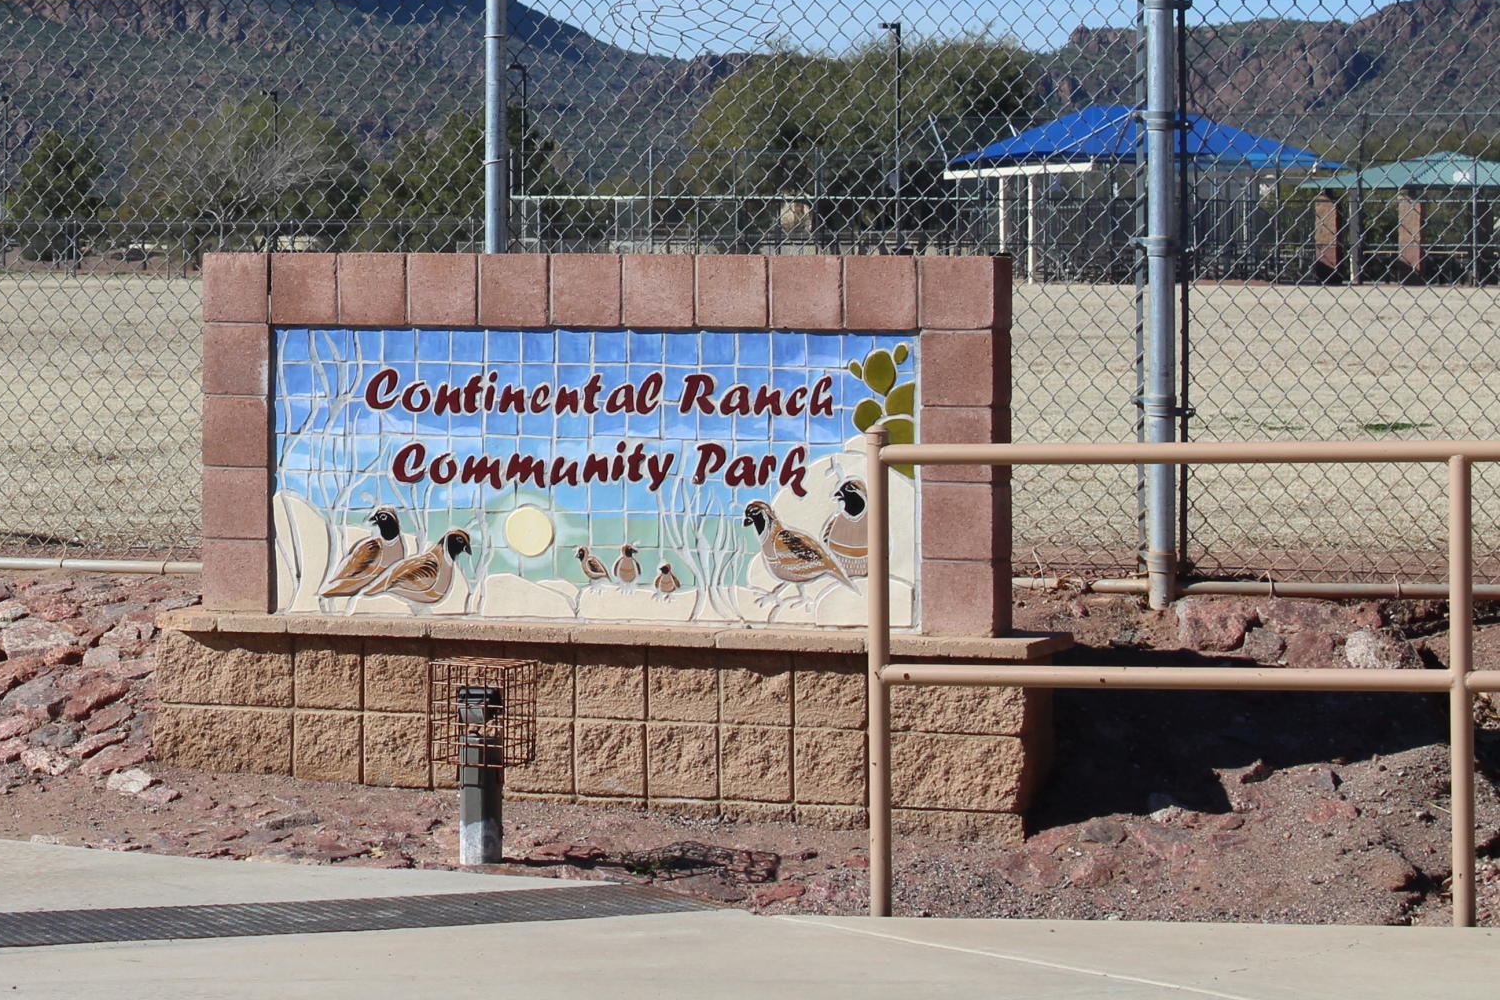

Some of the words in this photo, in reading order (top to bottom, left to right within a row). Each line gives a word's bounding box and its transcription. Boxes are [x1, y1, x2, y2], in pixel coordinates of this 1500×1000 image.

[364, 367, 664, 416] Continental
[680, 372, 834, 418] Ranch
[391, 441, 676, 491] Community
[693, 441, 809, 499] Park
